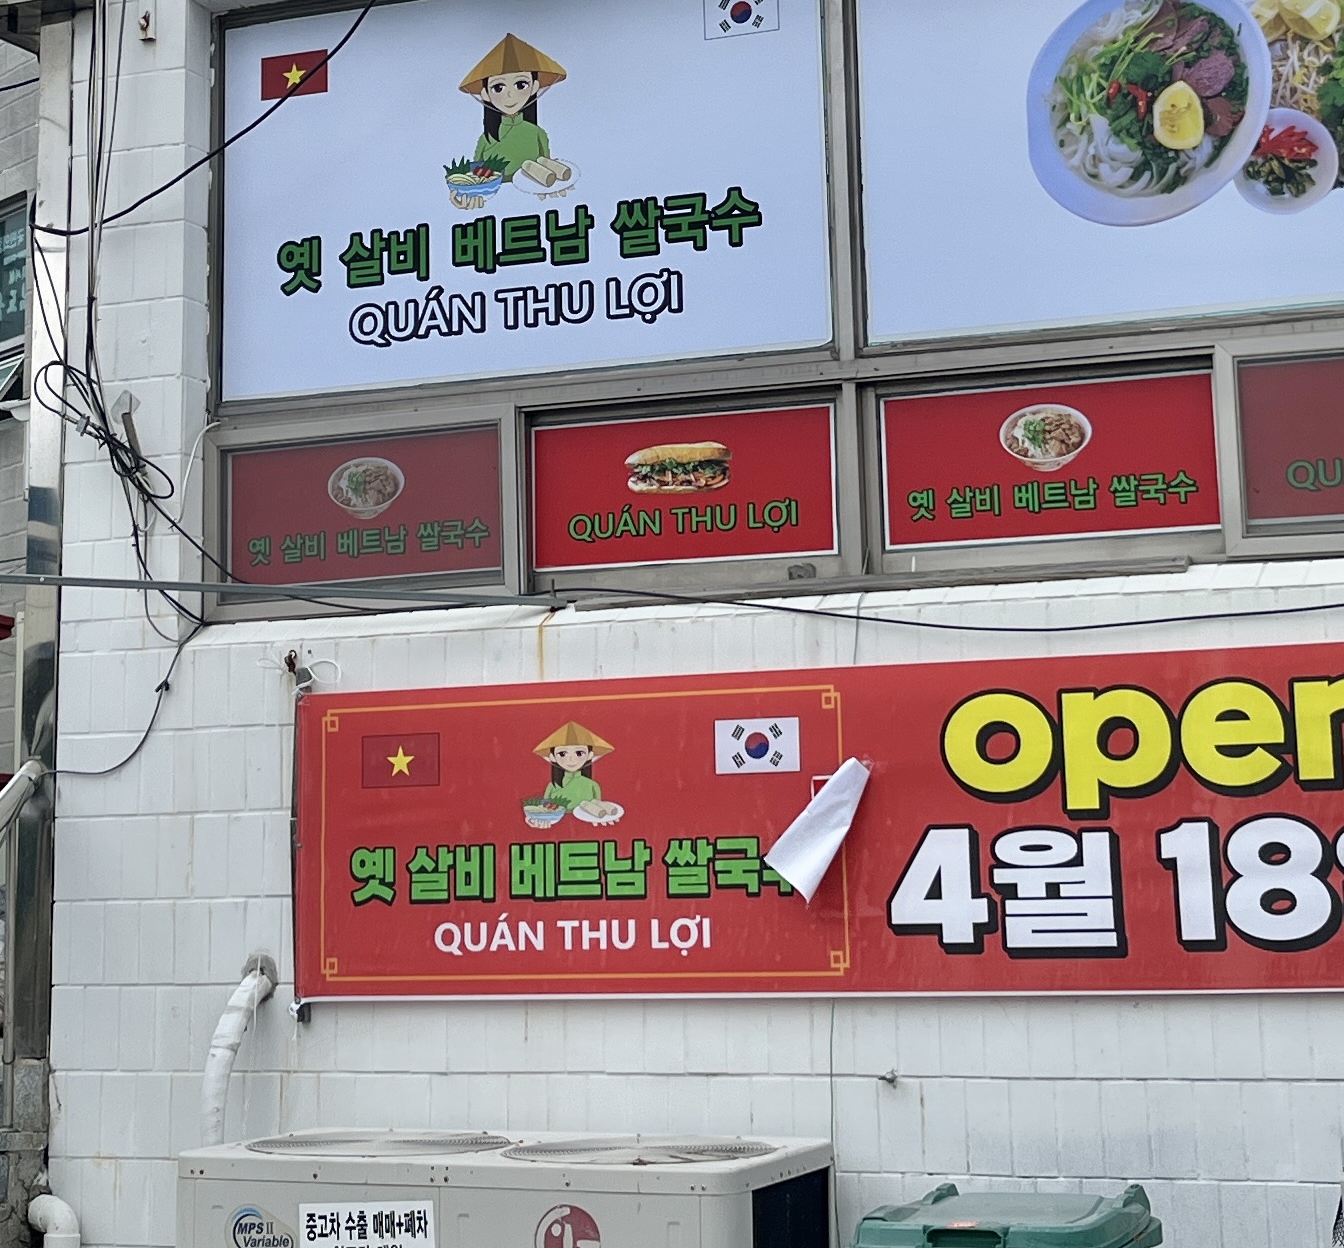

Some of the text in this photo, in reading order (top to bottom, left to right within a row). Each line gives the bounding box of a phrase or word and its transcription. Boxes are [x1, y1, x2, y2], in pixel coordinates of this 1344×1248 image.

[277, 186, 762, 296] 옛 살비 베트남 쌀국수
[350, 270, 683, 347] QUÁN THU LỢI
[907, 469, 1198, 521] 옛 살비 베트남 쌀국수
[248, 518, 490, 567] 옛 살비 베트남 쌀국수
[568, 498, 799, 543] QUÁN THU LỢI
[350, 846, 396, 906] 옛
[407, 843, 496, 903] 살비
[508, 838, 652, 903] 베트남
[886, 825, 1128, 958] 4월
[434, 913, 711, 956] QUÁN THU LỢI
[237, 1222, 264, 1234] MPS
[243, 1235, 291, 1248] Variable
[306, 1209, 428, 1241] 중고차 수출 매매+폐차
